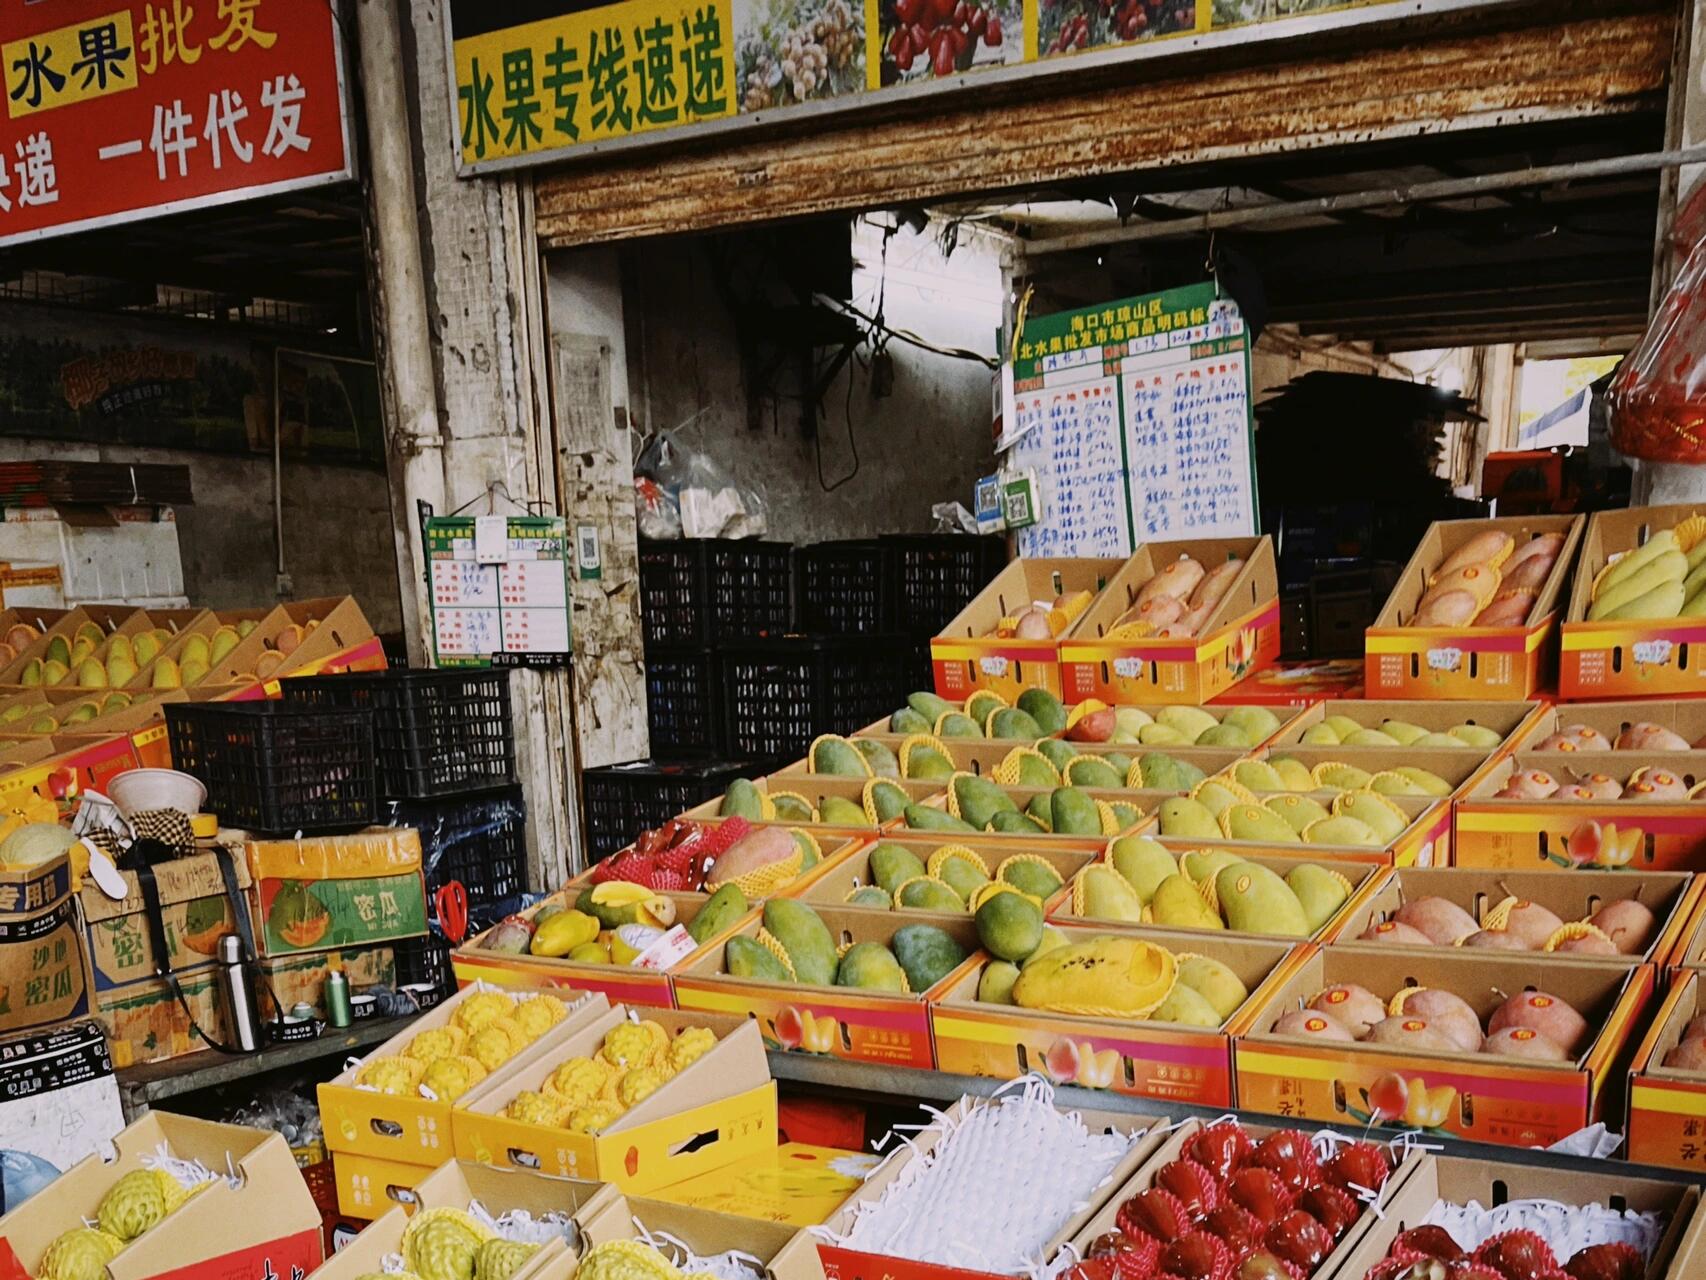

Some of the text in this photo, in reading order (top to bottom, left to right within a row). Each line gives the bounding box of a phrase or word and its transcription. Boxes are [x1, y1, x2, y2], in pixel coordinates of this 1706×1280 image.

[10, 0, 278, 107] 水果批发
[459, 4, 727, 158] 水果专线速递
[99, 74, 312, 181] 一件代发
[1014, 308, 1210, 361] 北水果批发市场商品明码标
[1071, 298, 1163, 332] 海口市琼山区
